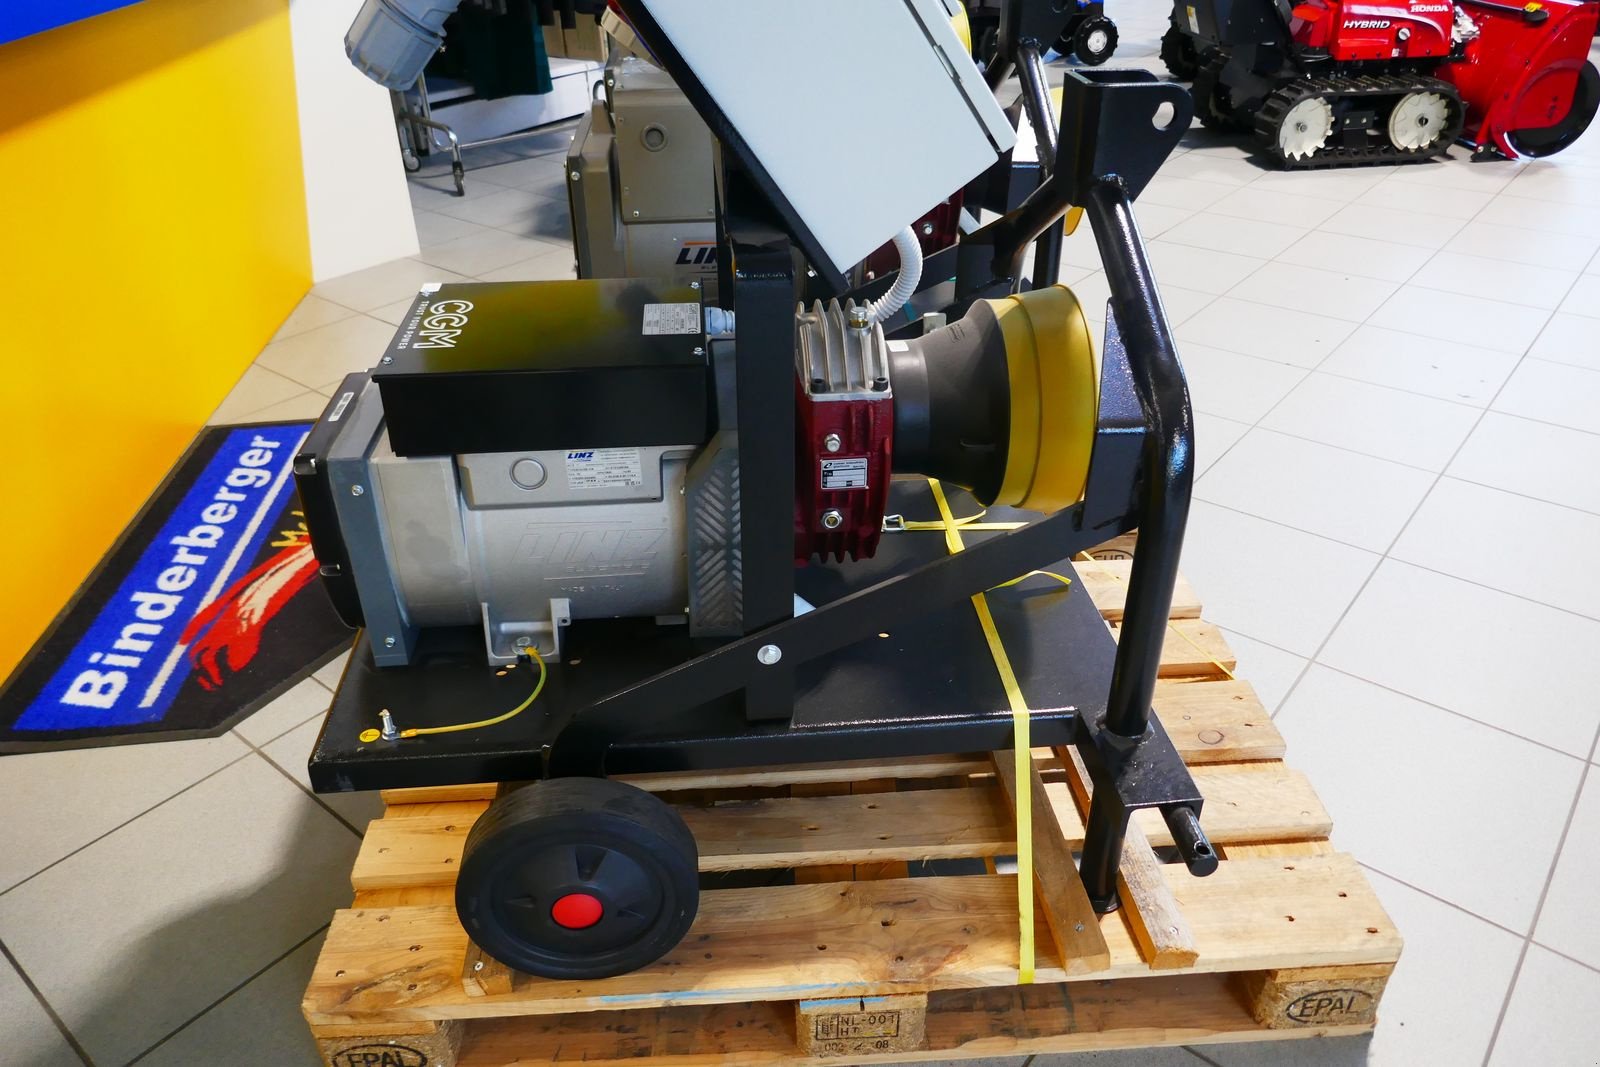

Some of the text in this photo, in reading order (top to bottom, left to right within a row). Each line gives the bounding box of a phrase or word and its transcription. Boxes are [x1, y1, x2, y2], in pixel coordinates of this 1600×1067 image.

[1410, 4, 1449, 13] HONDA
[1343, 20, 1391, 29] HYBRID
[396, 300, 430, 350] TRUST YOUR POWER
[412, 299, 474, 349] CGM
[567, 451, 594, 459] LINZ
[59, 435, 281, 709] Binderberger
[1298, 996, 1360, 1018] EPAL
